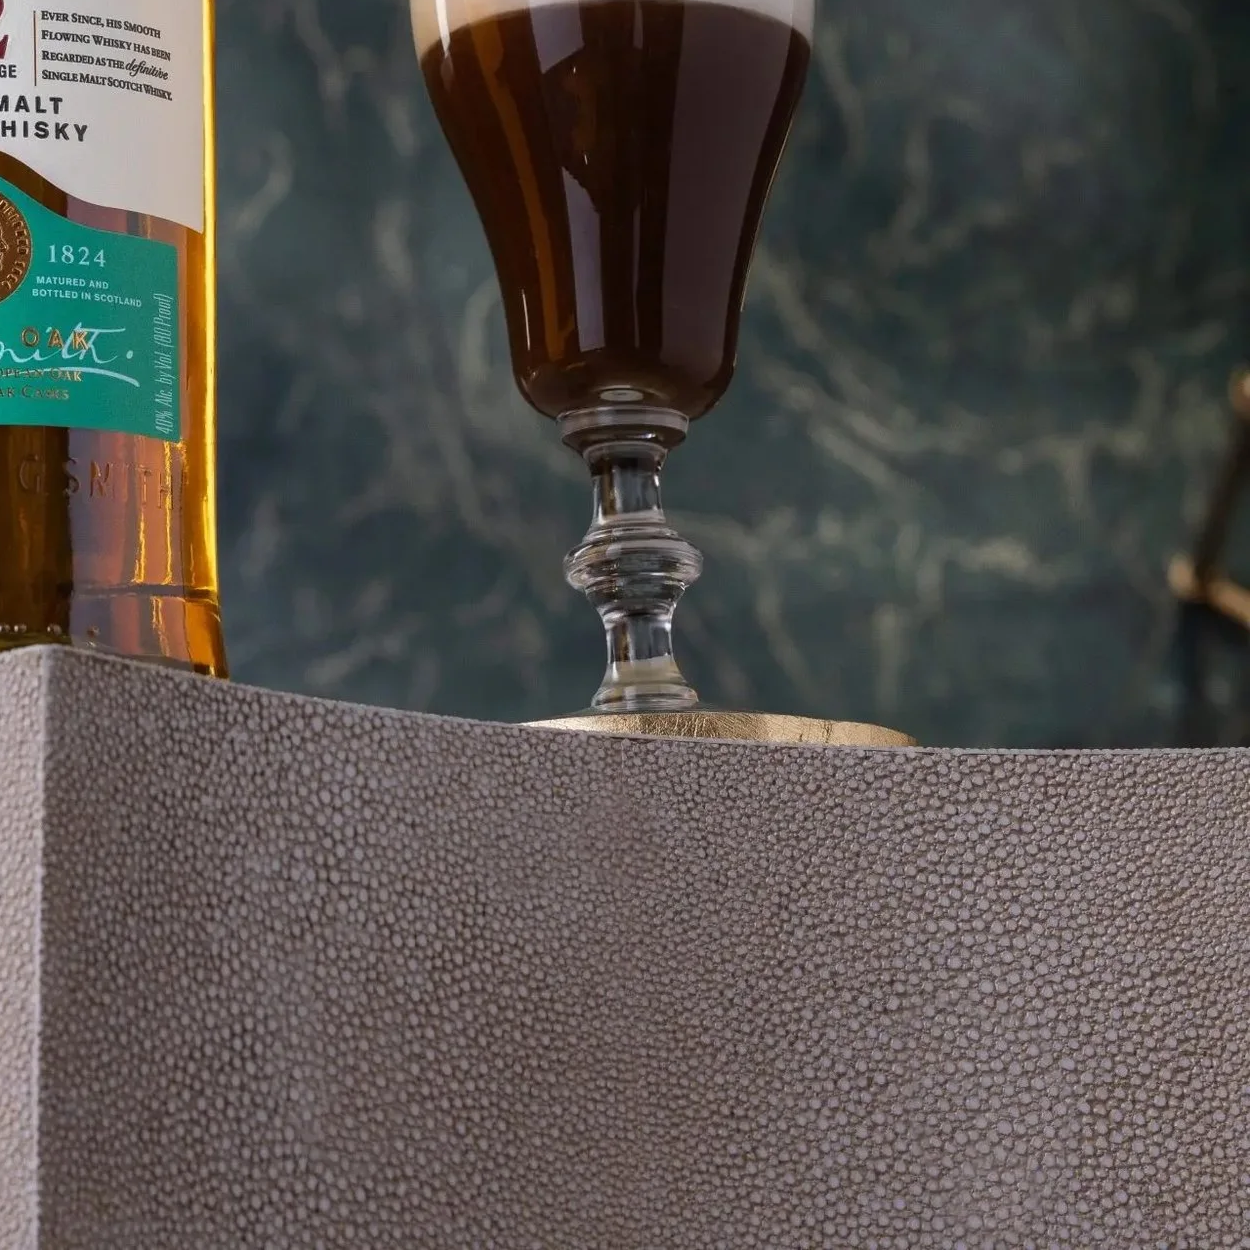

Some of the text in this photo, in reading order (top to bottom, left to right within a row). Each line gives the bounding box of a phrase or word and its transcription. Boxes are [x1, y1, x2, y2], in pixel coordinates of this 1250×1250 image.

[41, 10, 161, 39] EVER SINCE, HIS SMOOTH
[41, 30, 171, 61] FLOWING WHISKY HAS BEEN
[41, 50, 169, 81] REGARDED AS THE definitive
[42, 70, 78, 82] SINGLE
[79, 73, 107, 86] MALT
[108, 77, 143, 93] SCOTCH
[48, 244, 106, 268] 1824
[36, 276, 109, 290] MATURED AND
[32, 288, 142, 308] BOTTLED IN SCOTLAND
[21, 326, 90, 350] OAK
[50, 367, 83, 383] OAK
[155, 370, 176, 385] by
[21, 386, 70, 400] CASKS
[155, 410, 174, 434] 40%
